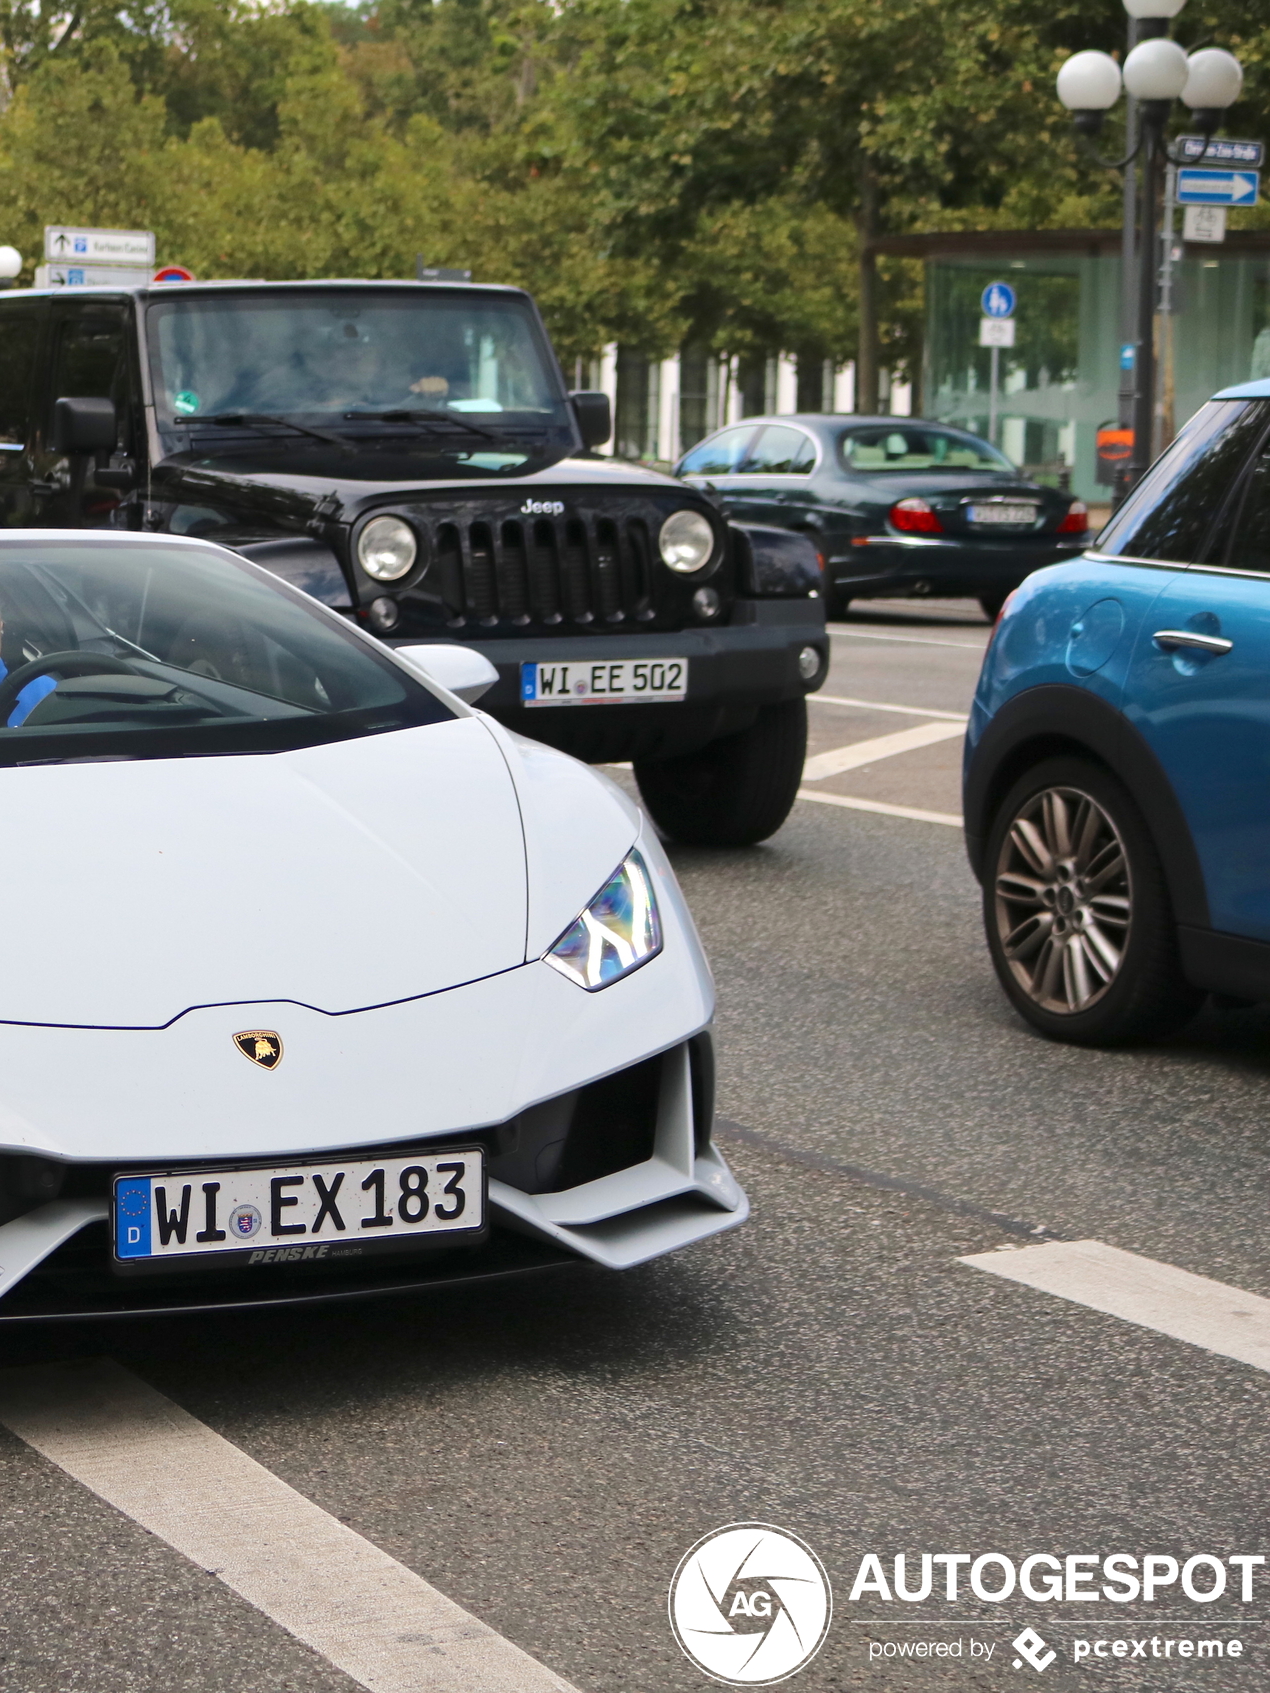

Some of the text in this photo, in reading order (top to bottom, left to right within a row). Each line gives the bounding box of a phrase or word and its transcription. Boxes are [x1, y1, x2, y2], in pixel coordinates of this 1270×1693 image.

[521, 498, 564, 516] Jeep
[540, 667, 570, 694] WI
[591, 665, 624, 693] EE
[633, 664, 682, 691] 502
[236, 1032, 276, 1041] LAMBORGHINI
[128, 1227, 140, 1244] D
[155, 1182, 226, 1245] WI
[270, 1172, 346, 1236] EX
[361, 1162, 466, 1228] 183
[248, 1245, 363, 1264] PENSKE HAMBURG
